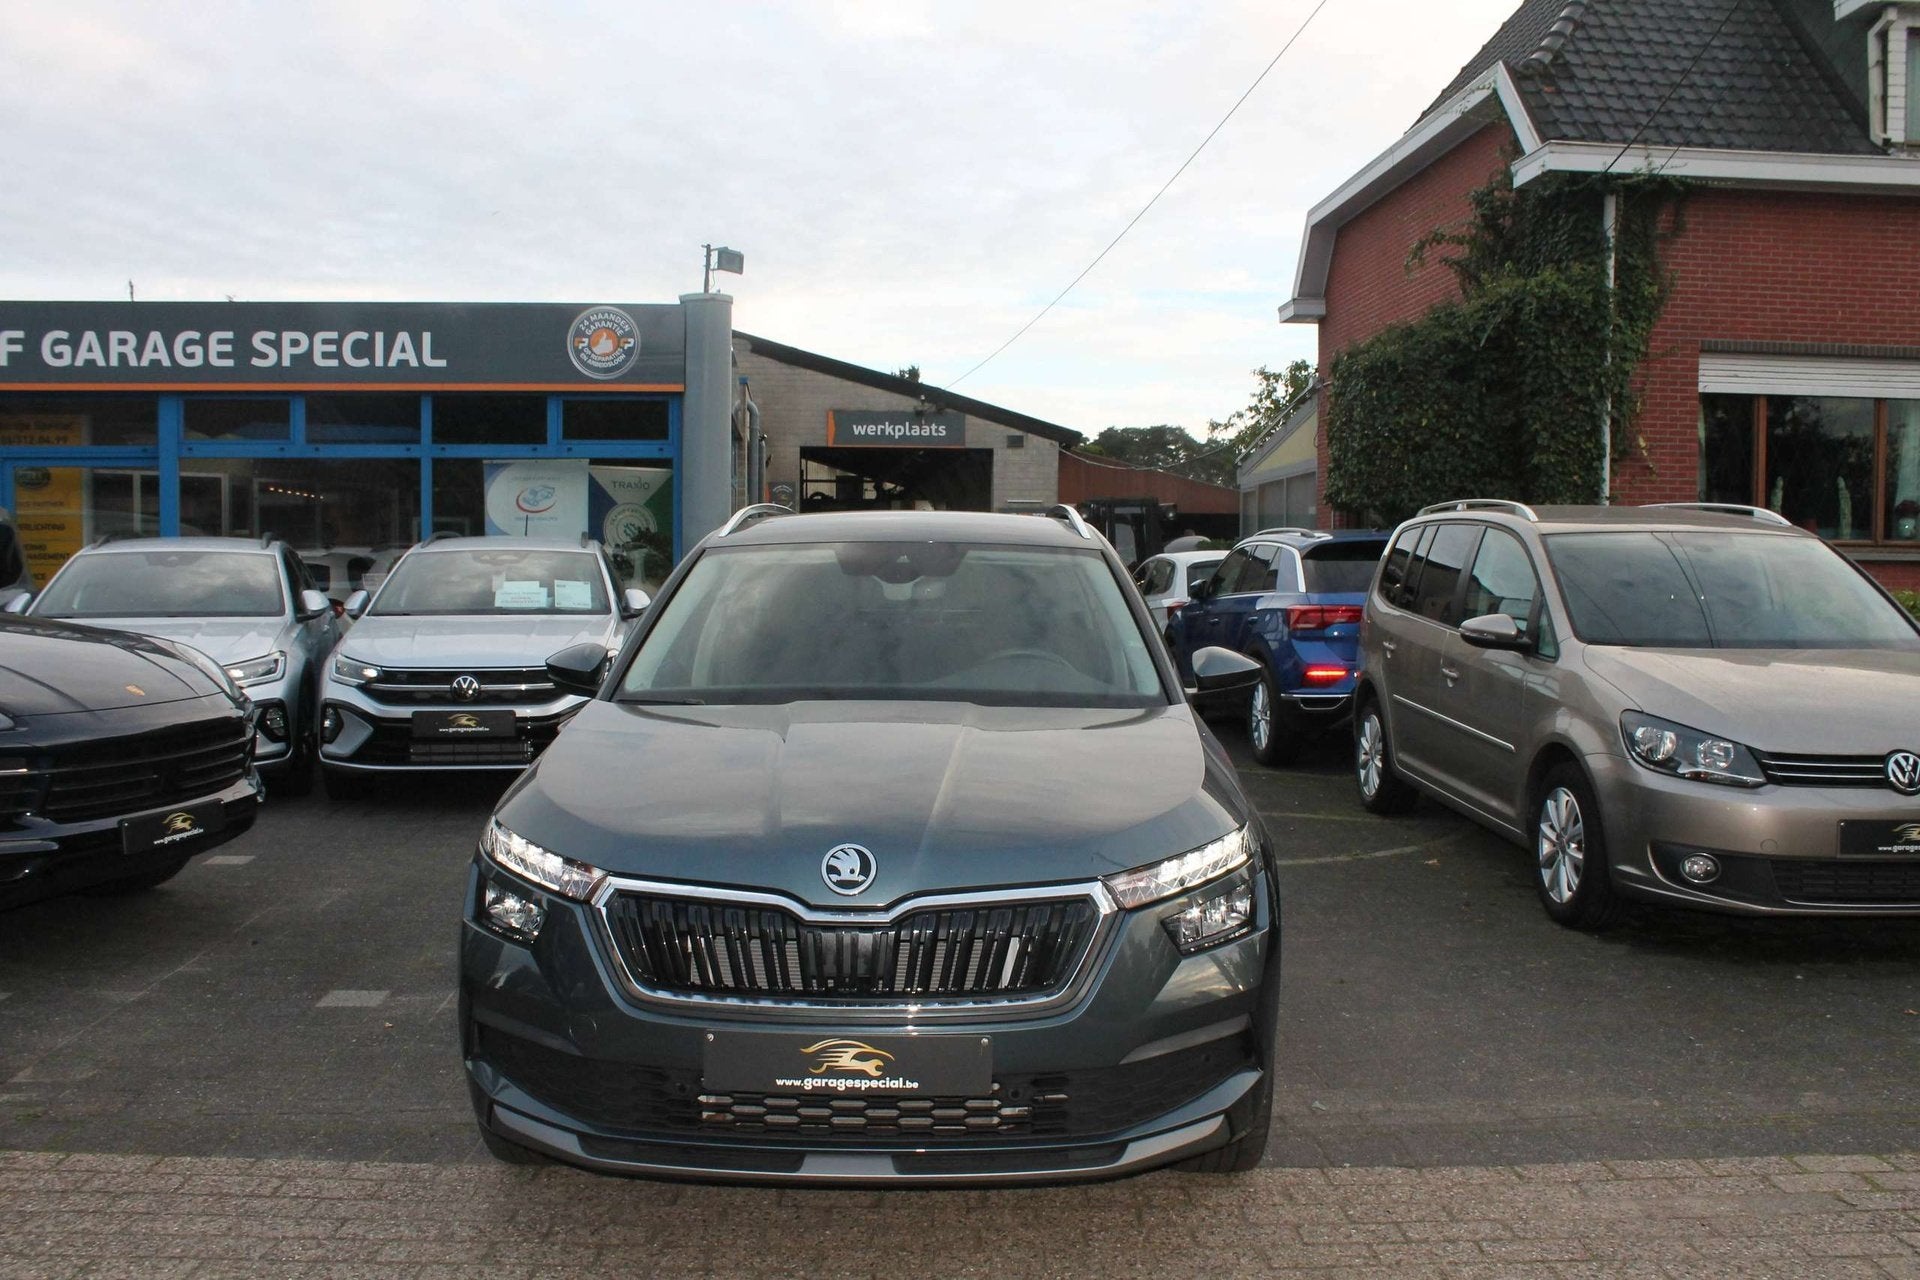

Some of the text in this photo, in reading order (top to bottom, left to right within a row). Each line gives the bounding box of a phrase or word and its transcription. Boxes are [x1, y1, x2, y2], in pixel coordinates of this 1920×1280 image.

[579, 312, 631, 332] 24 MAANDEN
[585, 320, 624, 337] GARANTIE
[41, 331, 235, 367] GARAGE
[251, 331, 447, 367] SPECIAL
[853, 421, 946, 439] werkplaats
[611, 479, 650, 490] TRAXIO
[775, 1077, 919, 1091] www.garagespecial.be
